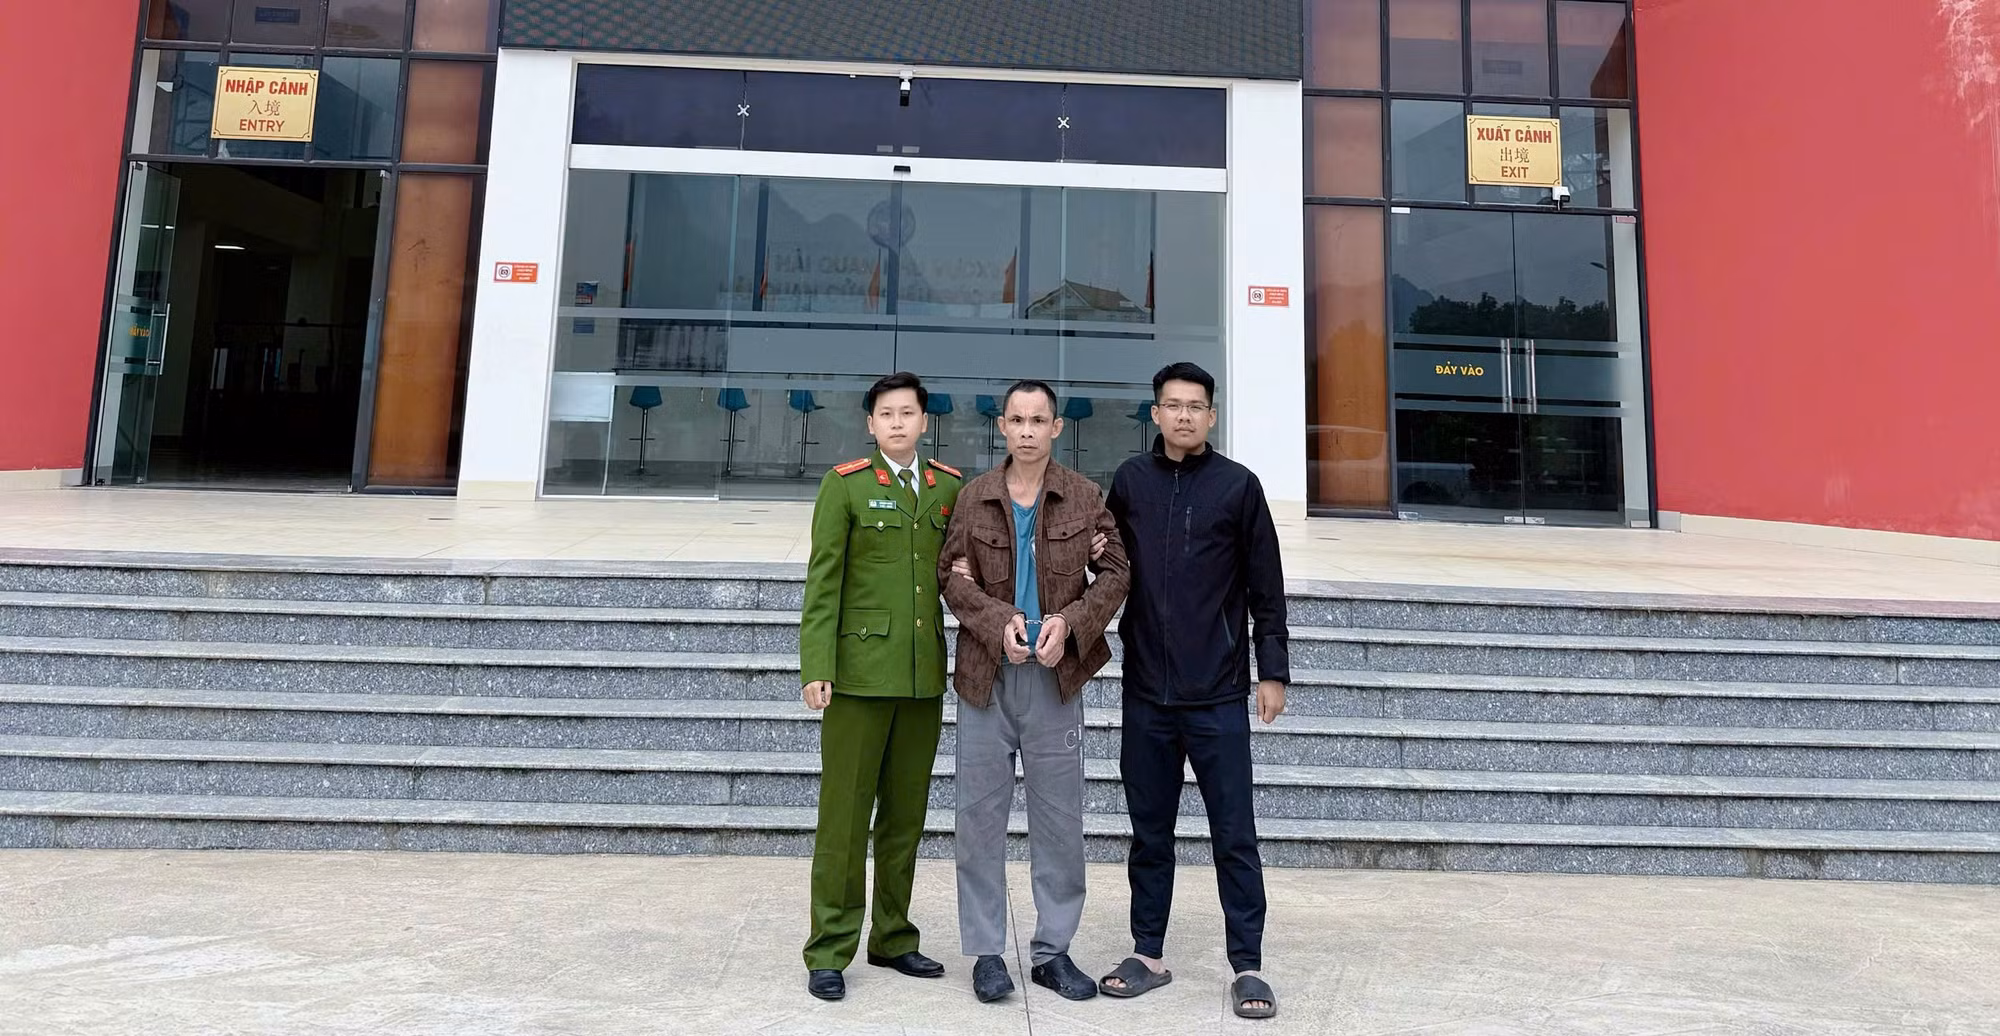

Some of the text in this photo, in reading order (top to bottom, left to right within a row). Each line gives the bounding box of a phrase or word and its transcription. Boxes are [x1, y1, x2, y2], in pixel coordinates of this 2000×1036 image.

[225, 77, 308, 96] NHẬP CẢNH
[248, 100, 281, 116] 入境
[239, 119, 285, 132] ENTRY
[1477, 124, 1552, 143] XUẤT CẢNH
[1500, 147, 1529, 163] 出境
[1501, 166, 1529, 178] EXIT
[1460, 364, 1484, 376] VÀO
